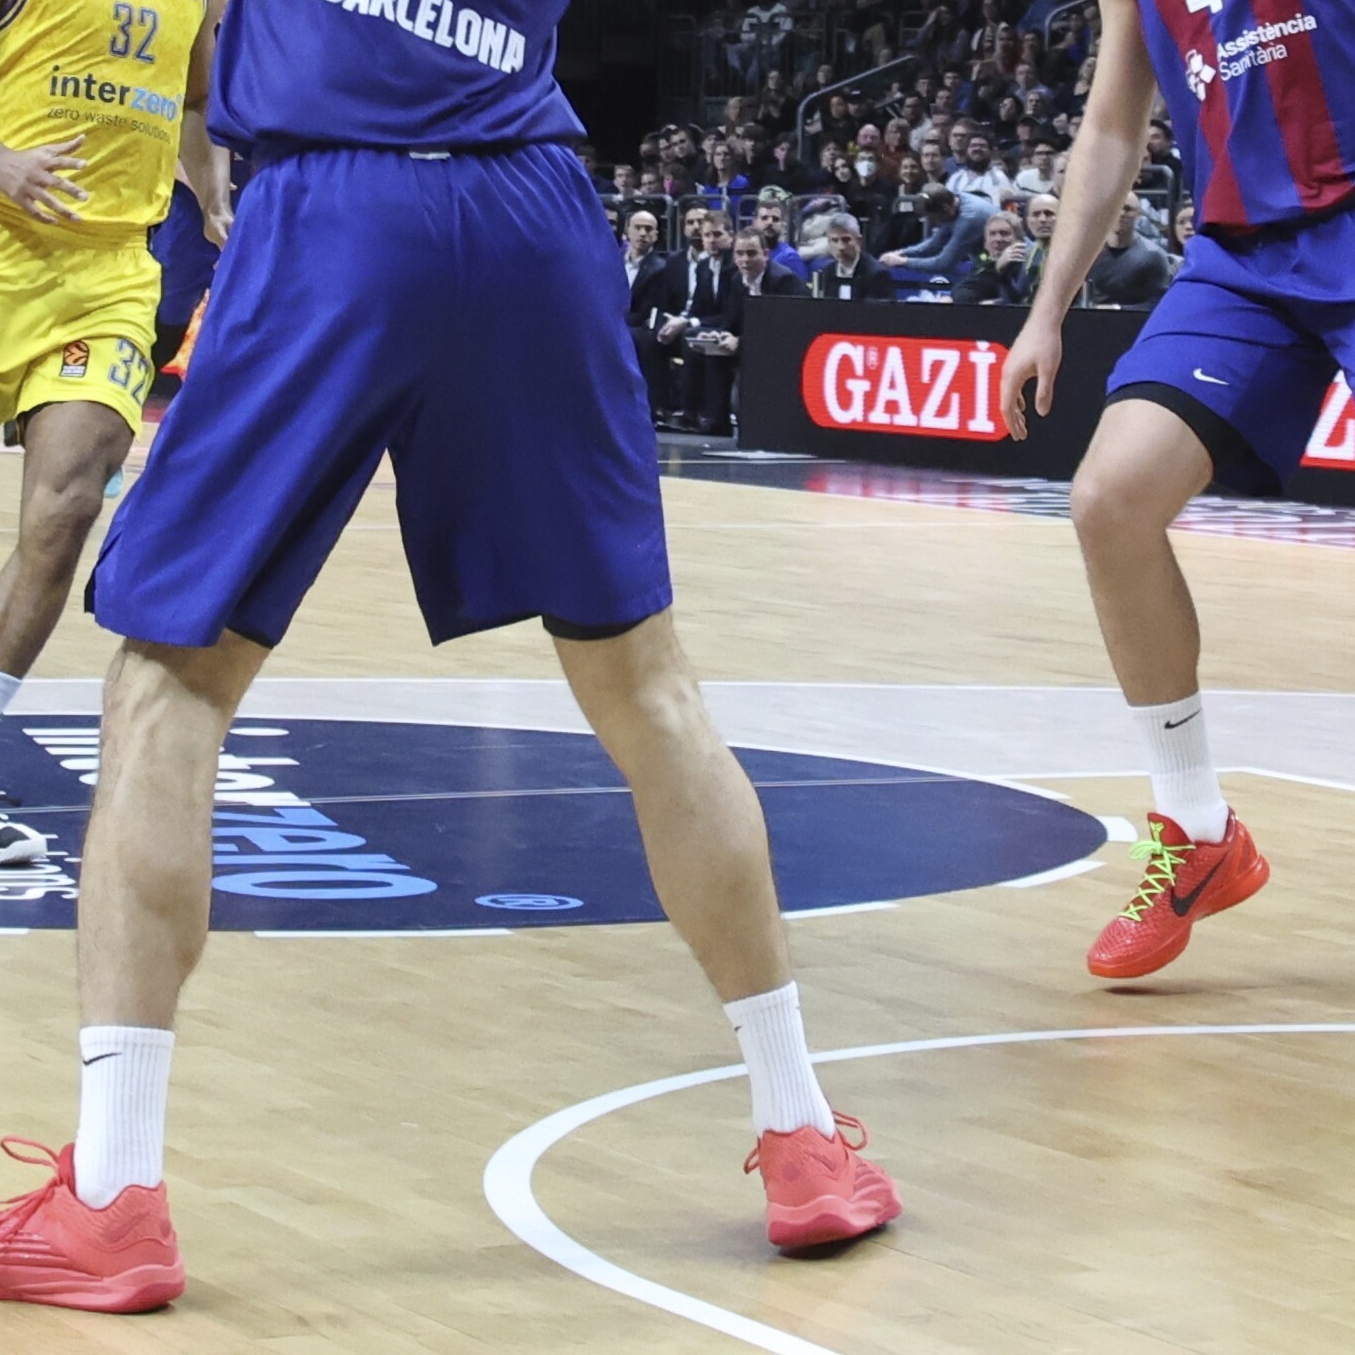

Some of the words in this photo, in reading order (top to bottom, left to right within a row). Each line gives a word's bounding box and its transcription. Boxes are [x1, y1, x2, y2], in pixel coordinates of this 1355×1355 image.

[109, 0, 159, 64] 32
[46, 107, 81, 122] zero
[84, 110, 128, 127] waste
[49, 64, 179, 122] interzero
